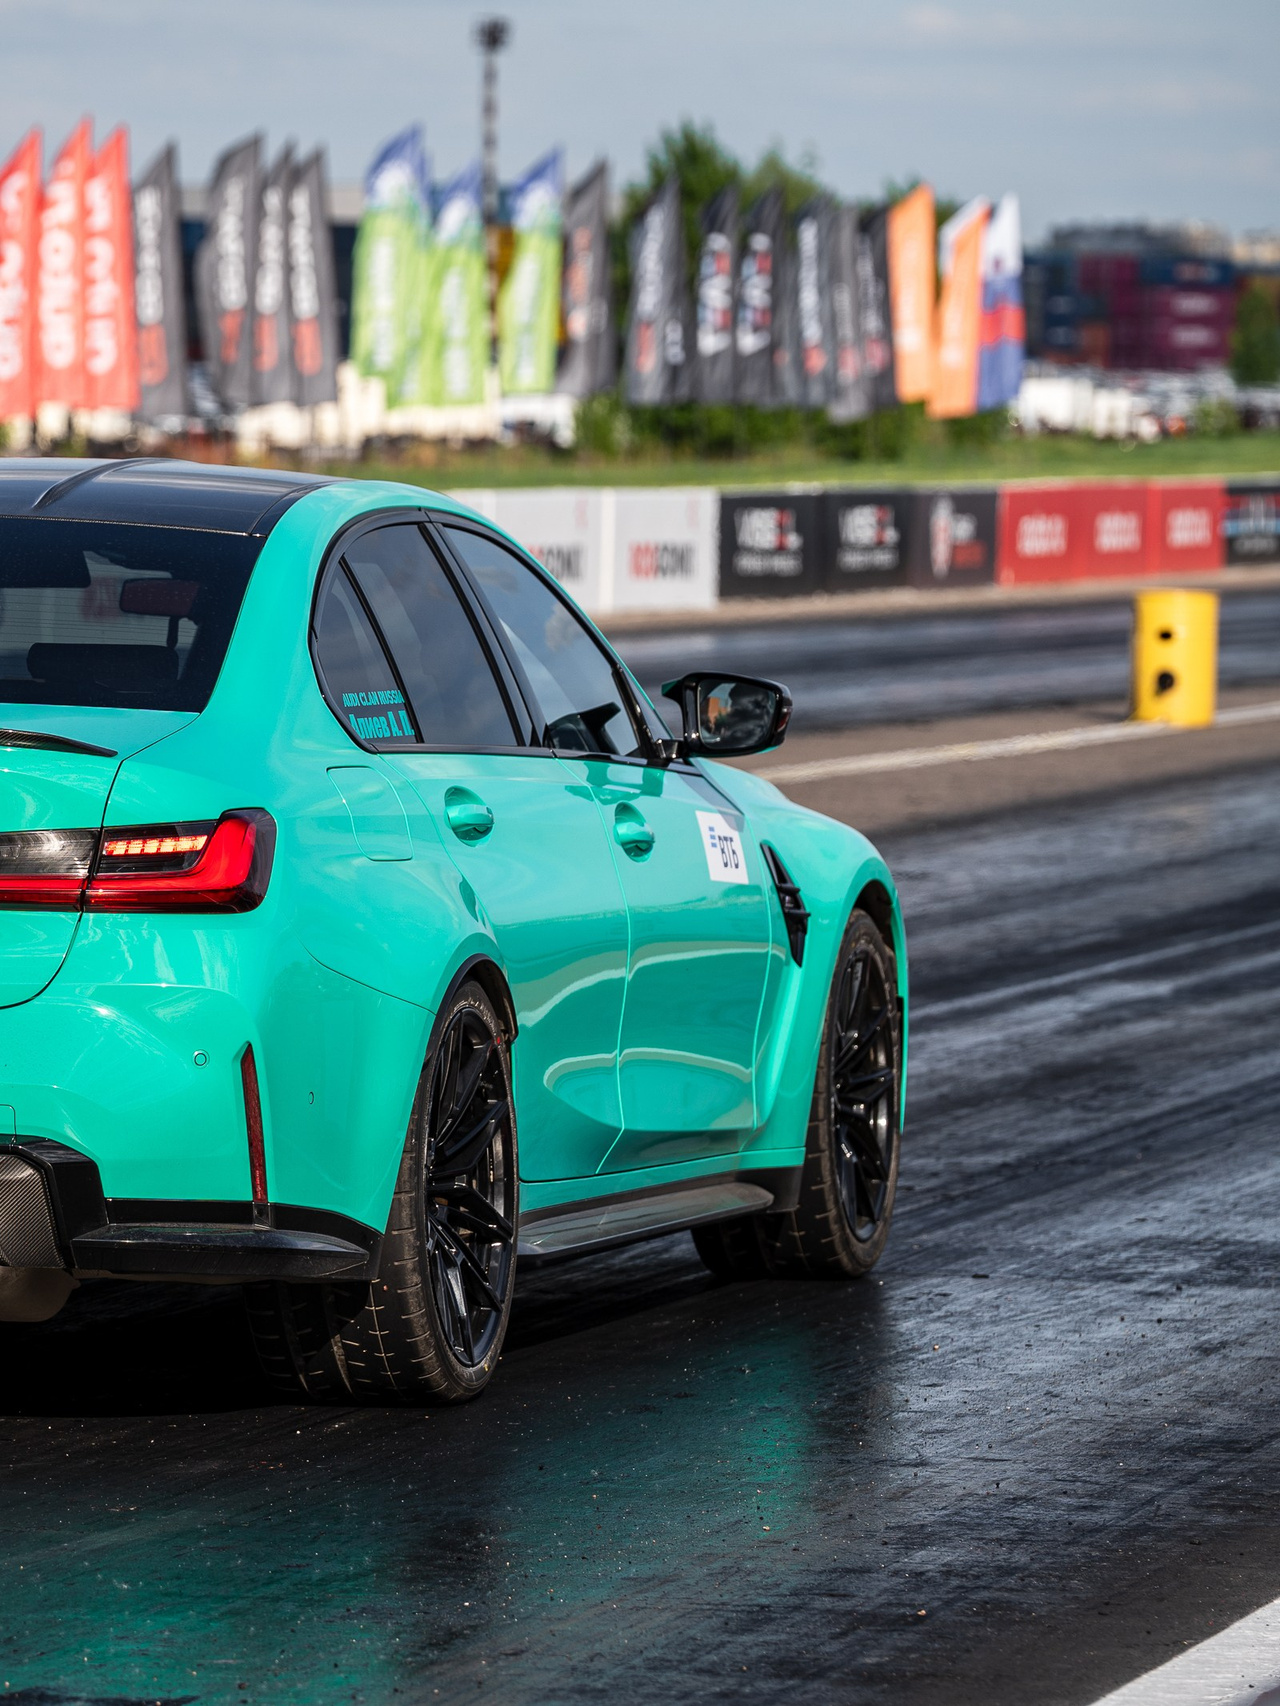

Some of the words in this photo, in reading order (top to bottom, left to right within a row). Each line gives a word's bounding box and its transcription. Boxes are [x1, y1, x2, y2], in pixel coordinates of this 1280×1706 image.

[342, 692, 361, 708] AUDI
[358, 690, 380, 706] CLAN
[376, 689, 406, 705] RUSSIA
[717, 834, 740, 870] ВТБ
